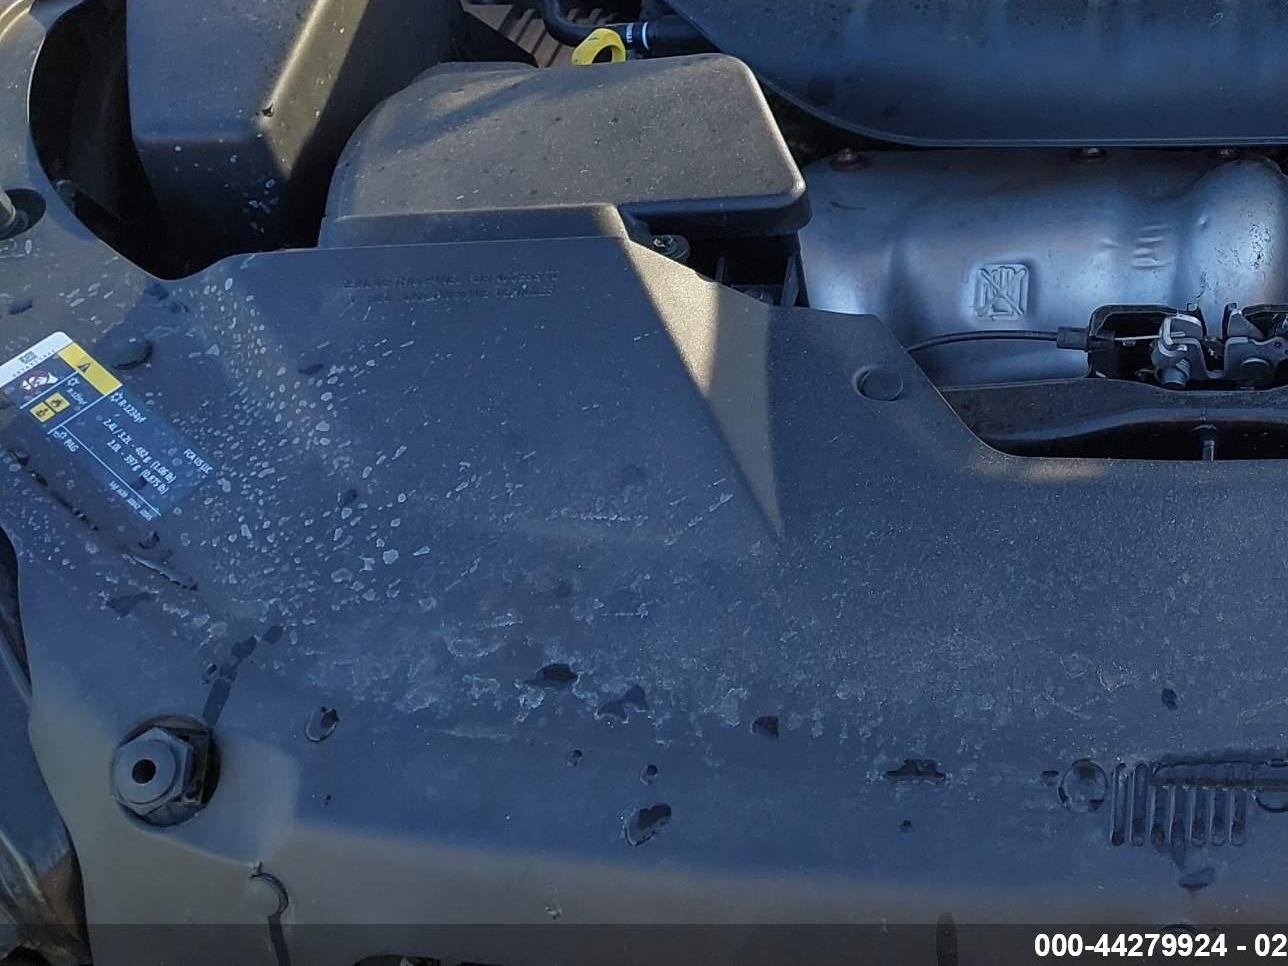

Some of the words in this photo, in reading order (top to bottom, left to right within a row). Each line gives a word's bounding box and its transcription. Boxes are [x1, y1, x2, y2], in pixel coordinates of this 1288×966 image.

[117, 399, 147, 423] R-1234yf
[63, 438, 80, 453] PAG
[183, 448, 197, 461] FCA
[192, 456, 204, 466] US
[200, 462, 213, 474] LLC
[123, 454, 138, 466] 397
[156, 483, 169, 495] lb)
